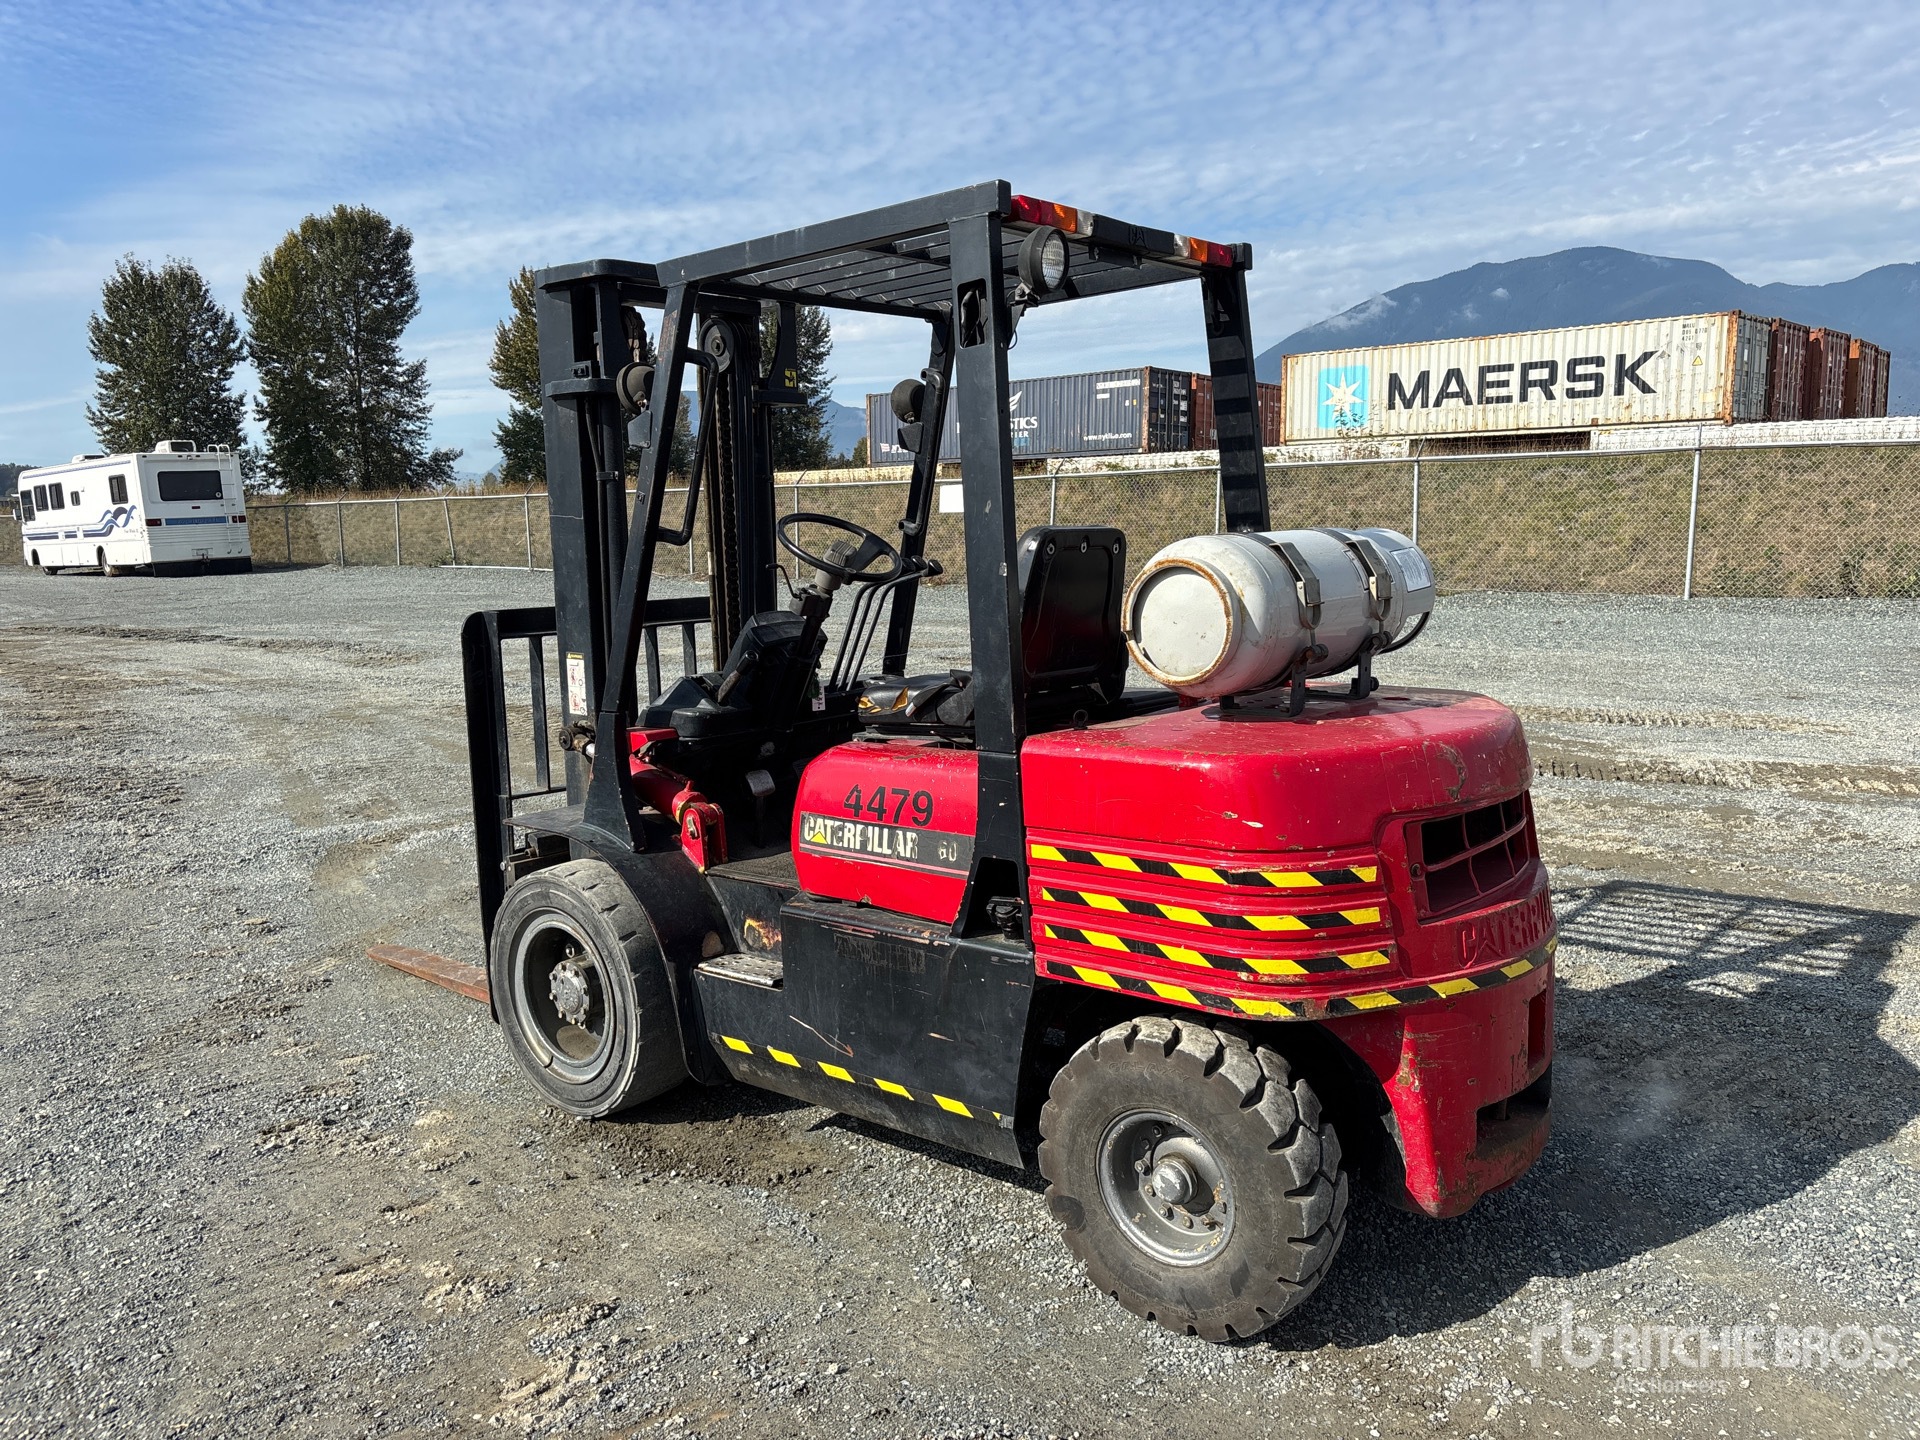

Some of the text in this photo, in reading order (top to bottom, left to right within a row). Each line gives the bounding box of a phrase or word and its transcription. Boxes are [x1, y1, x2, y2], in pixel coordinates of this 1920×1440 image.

[1388, 351, 1661, 411] MAERSK
[843, 784, 933, 826] 4479
[804, 816, 919, 859] CATERPILLAR
